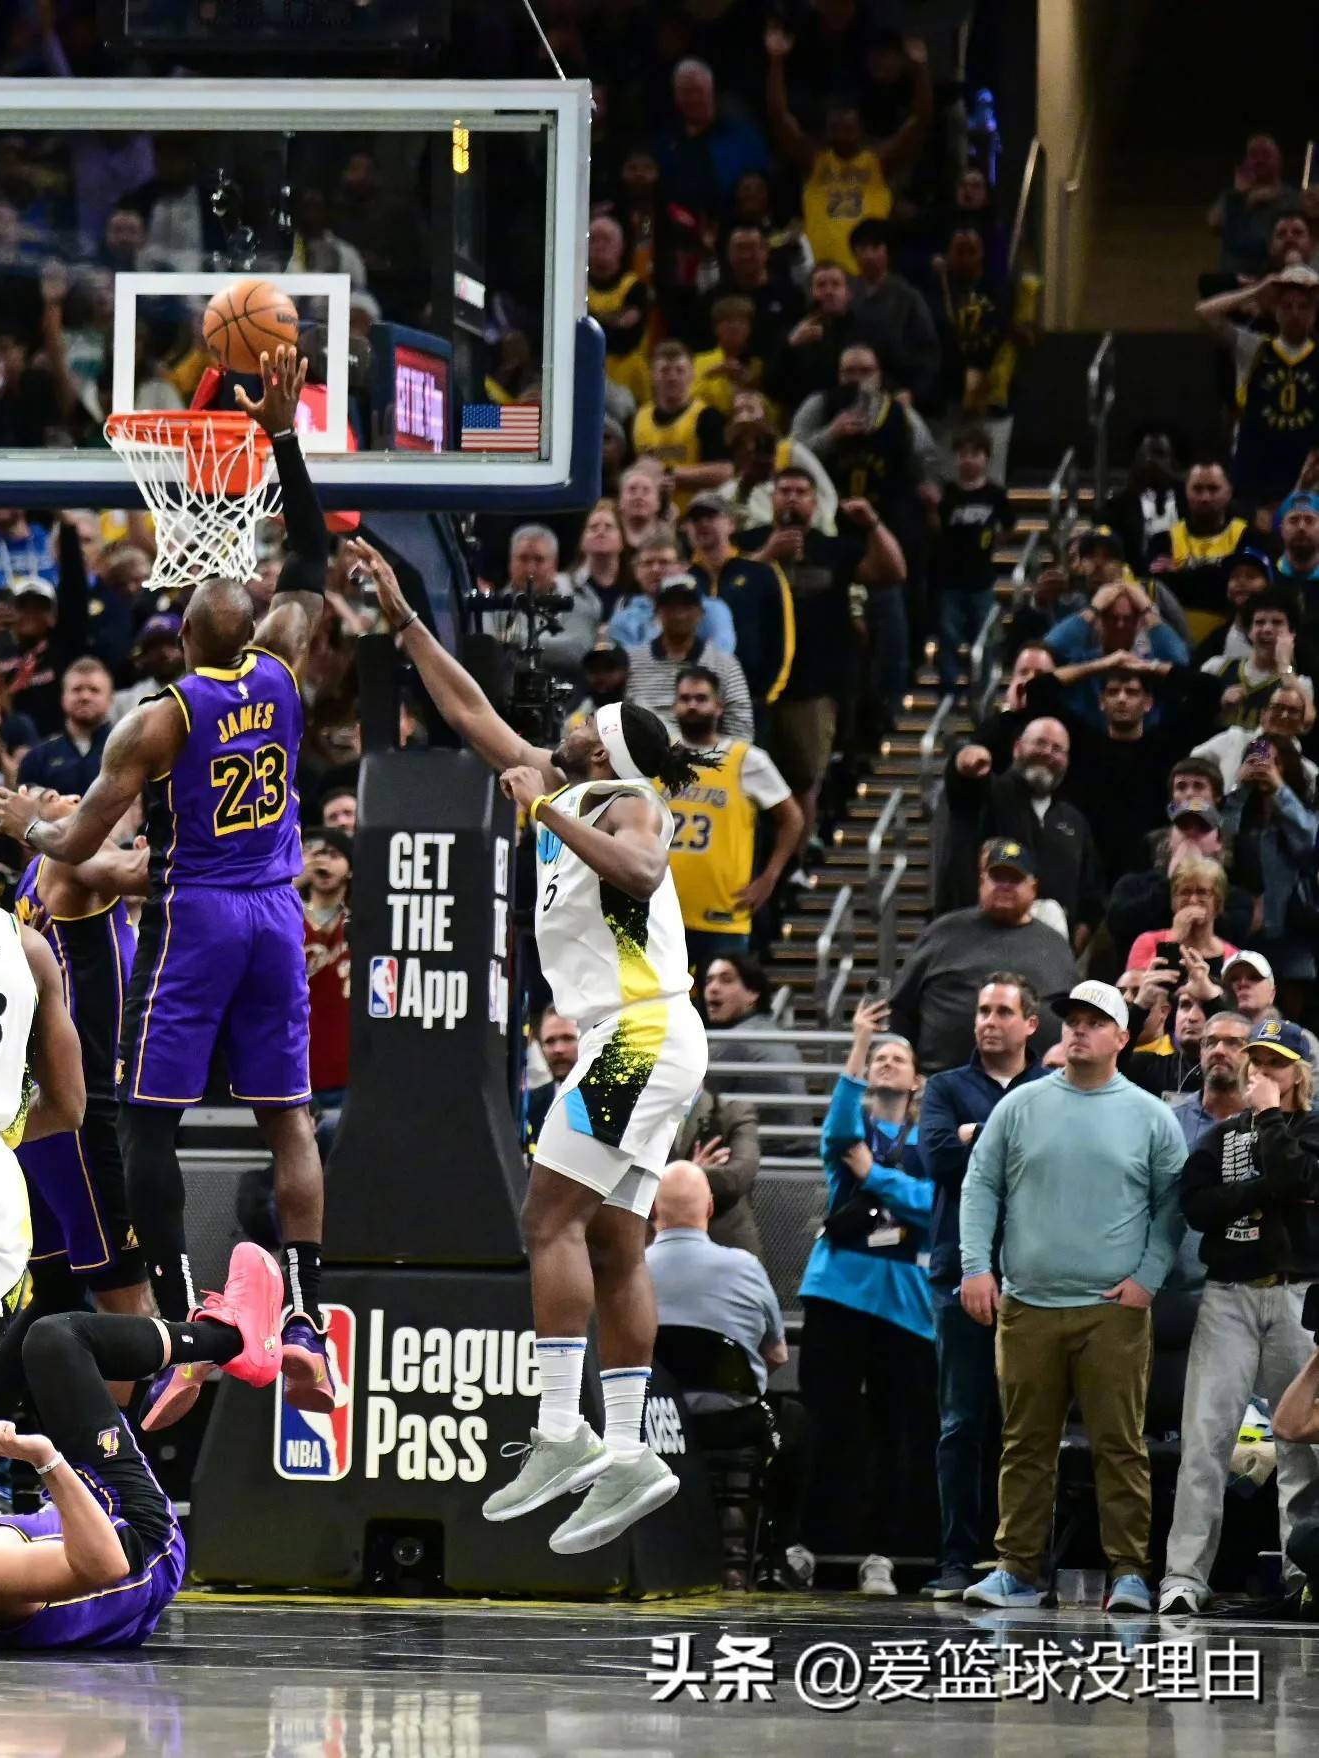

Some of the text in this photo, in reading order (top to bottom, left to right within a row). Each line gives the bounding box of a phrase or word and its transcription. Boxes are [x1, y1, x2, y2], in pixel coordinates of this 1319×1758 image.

[217, 702, 275, 744] JAMES
[210, 743, 288, 837] 23
[388, 831, 456, 890] GET
[670, 811, 713, 855] 23
[543, 874, 559, 912] 5
[387, 894, 455, 952] THE
[399, 957, 469, 1030] App
[368, 1308, 542, 1411] League
[285, 1439, 322, 1468] NBA
[365, 1396, 488, 1482] Pass
